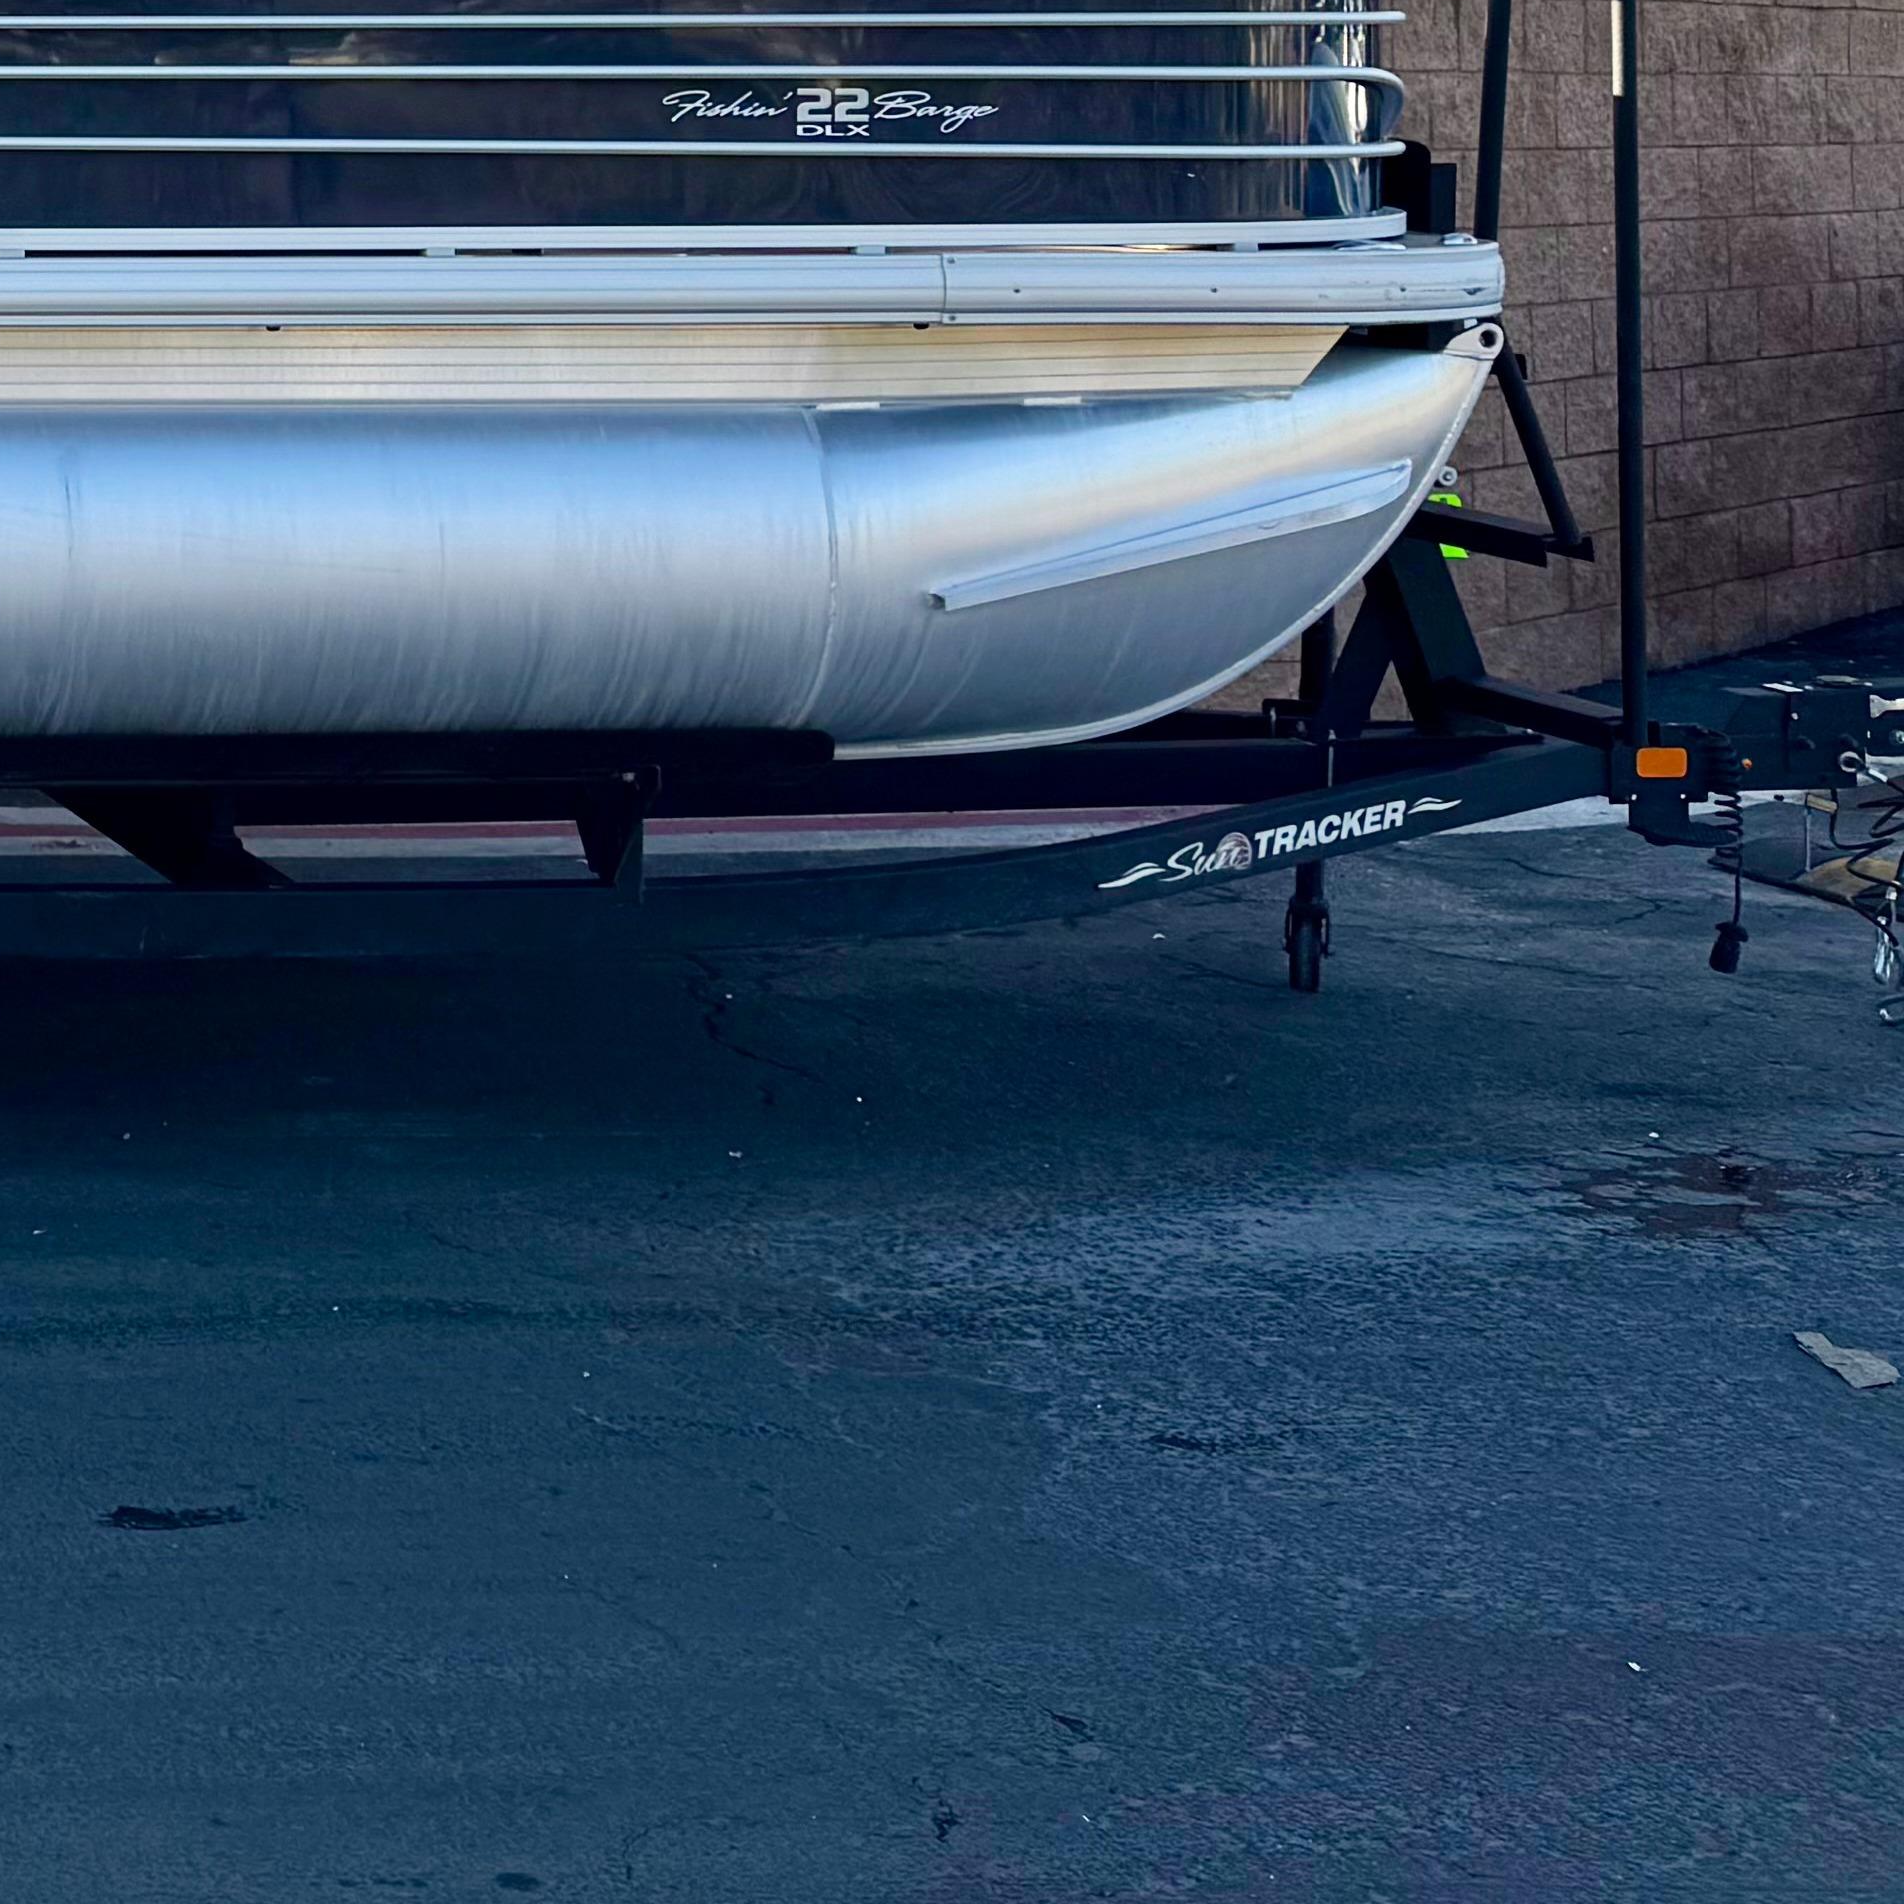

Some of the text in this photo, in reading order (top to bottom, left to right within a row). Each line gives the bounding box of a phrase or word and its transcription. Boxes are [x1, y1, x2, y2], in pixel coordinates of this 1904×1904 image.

[797, 88, 870, 122] 22
[874, 90, 999, 133] Barge
[797, 124, 870, 137] DLX
[1159, 799, 1406, 882] Sun TRACKER
